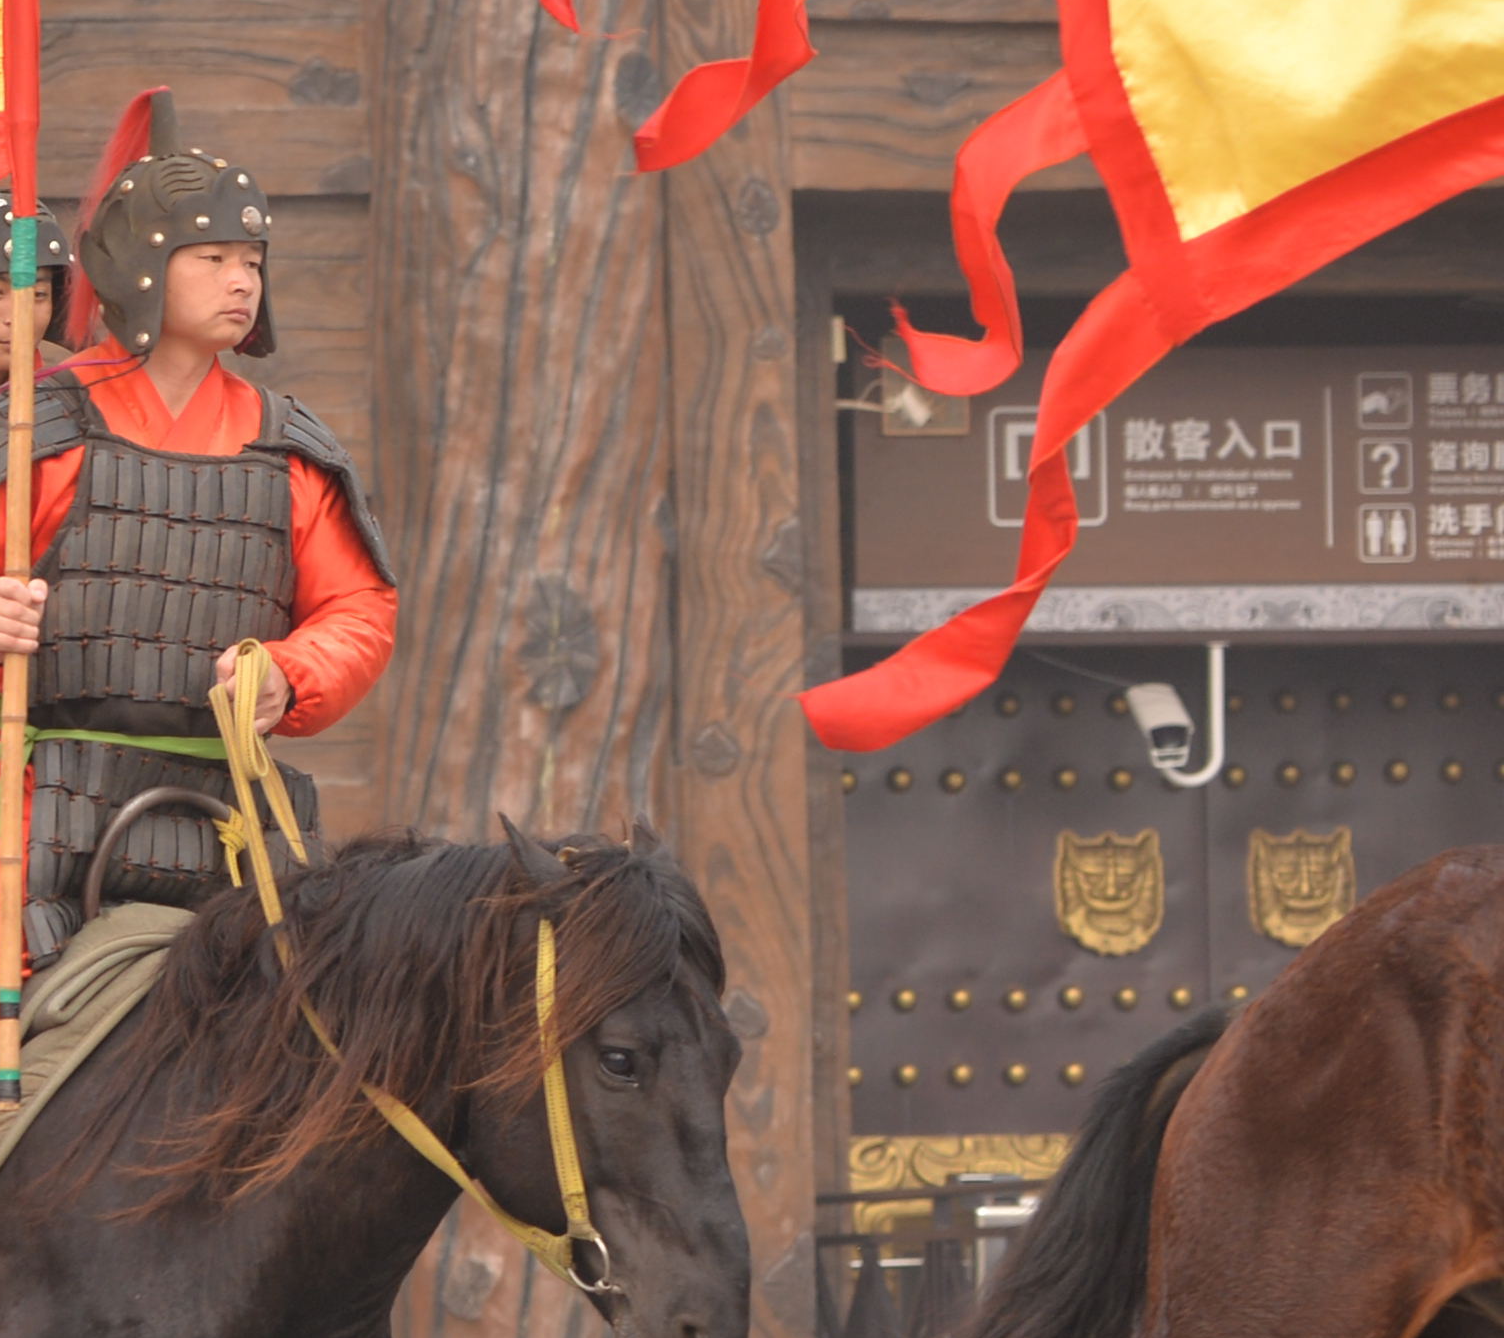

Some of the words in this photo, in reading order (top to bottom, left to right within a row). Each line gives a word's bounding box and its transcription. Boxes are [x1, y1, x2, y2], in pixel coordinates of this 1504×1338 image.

[1430, 372, 1504, 404] 票务
[1123, 417, 1301, 461] 散客入口
[1430, 503, 1504, 536] 洗手
